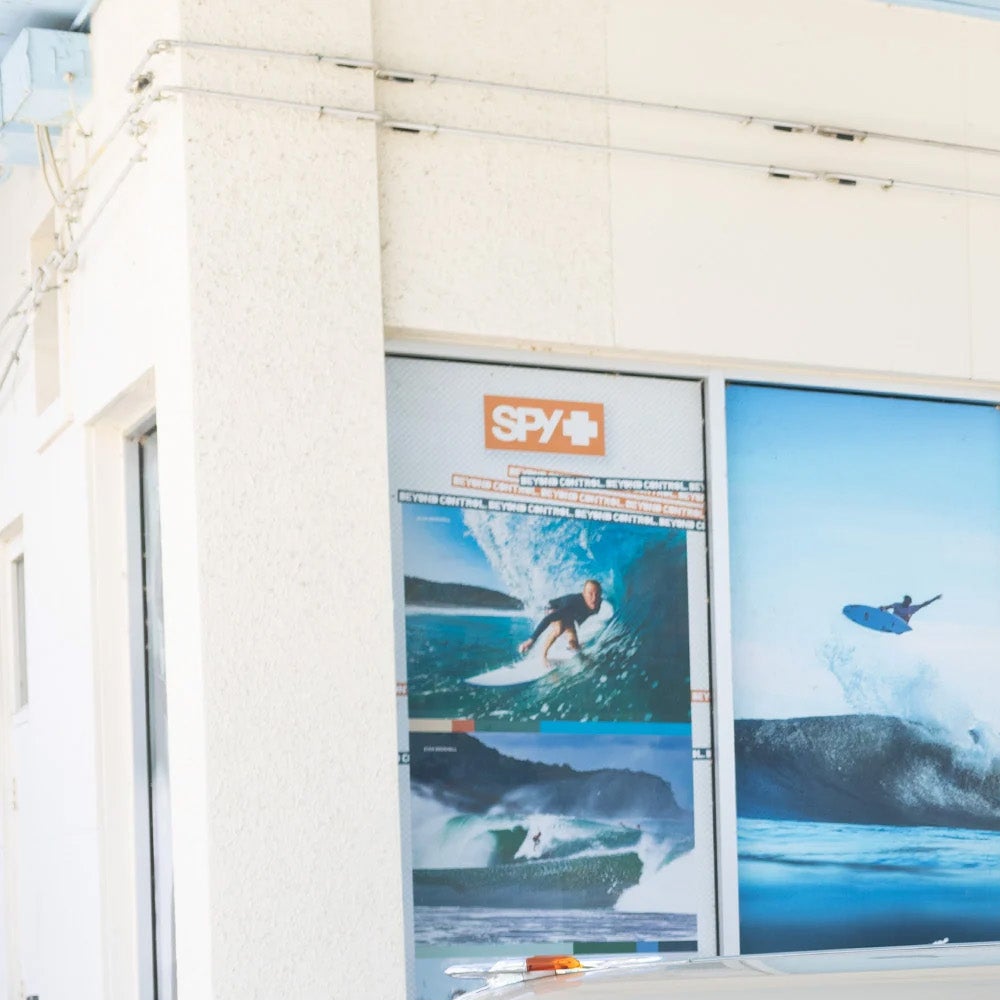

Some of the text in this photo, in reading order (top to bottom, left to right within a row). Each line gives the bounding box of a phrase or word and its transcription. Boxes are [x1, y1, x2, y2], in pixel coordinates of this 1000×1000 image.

[520, 475, 558, 487] BEYOND
[606, 478, 643, 490] BEYOND
[399, 491, 438, 504] BEYOND
[488, 500, 526, 513] BEYOND
[575, 508, 612, 522] BEYOND
[659, 516, 695, 530] BEYOND
